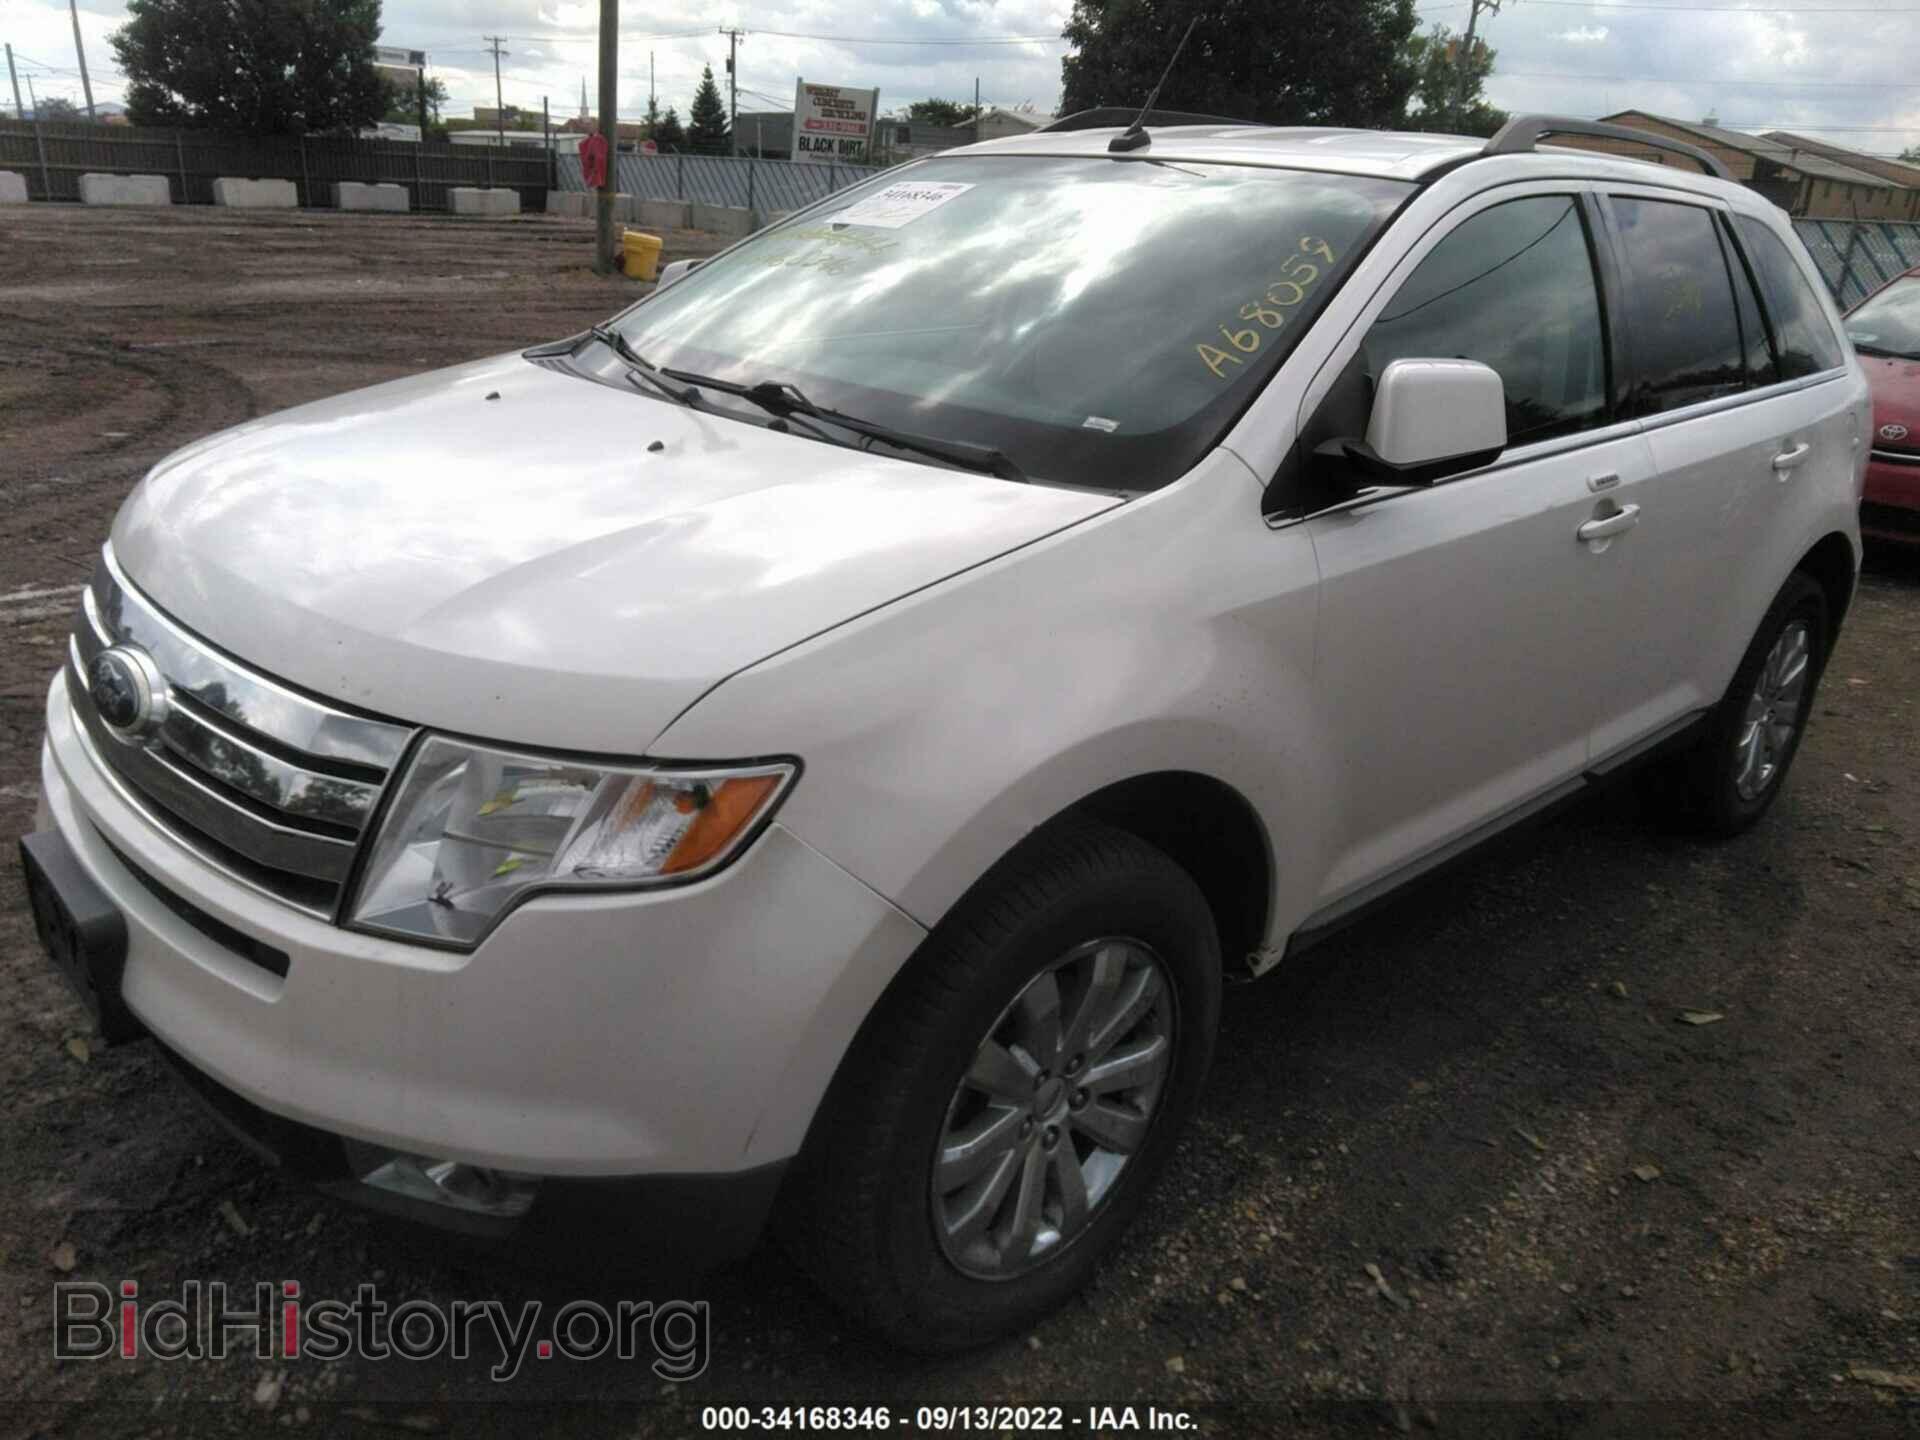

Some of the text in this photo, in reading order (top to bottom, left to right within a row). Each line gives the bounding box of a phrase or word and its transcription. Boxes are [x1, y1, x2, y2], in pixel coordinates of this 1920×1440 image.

[798, 136, 864, 156] BLACK DIRT
[1196, 236, 1334, 378] A68059
